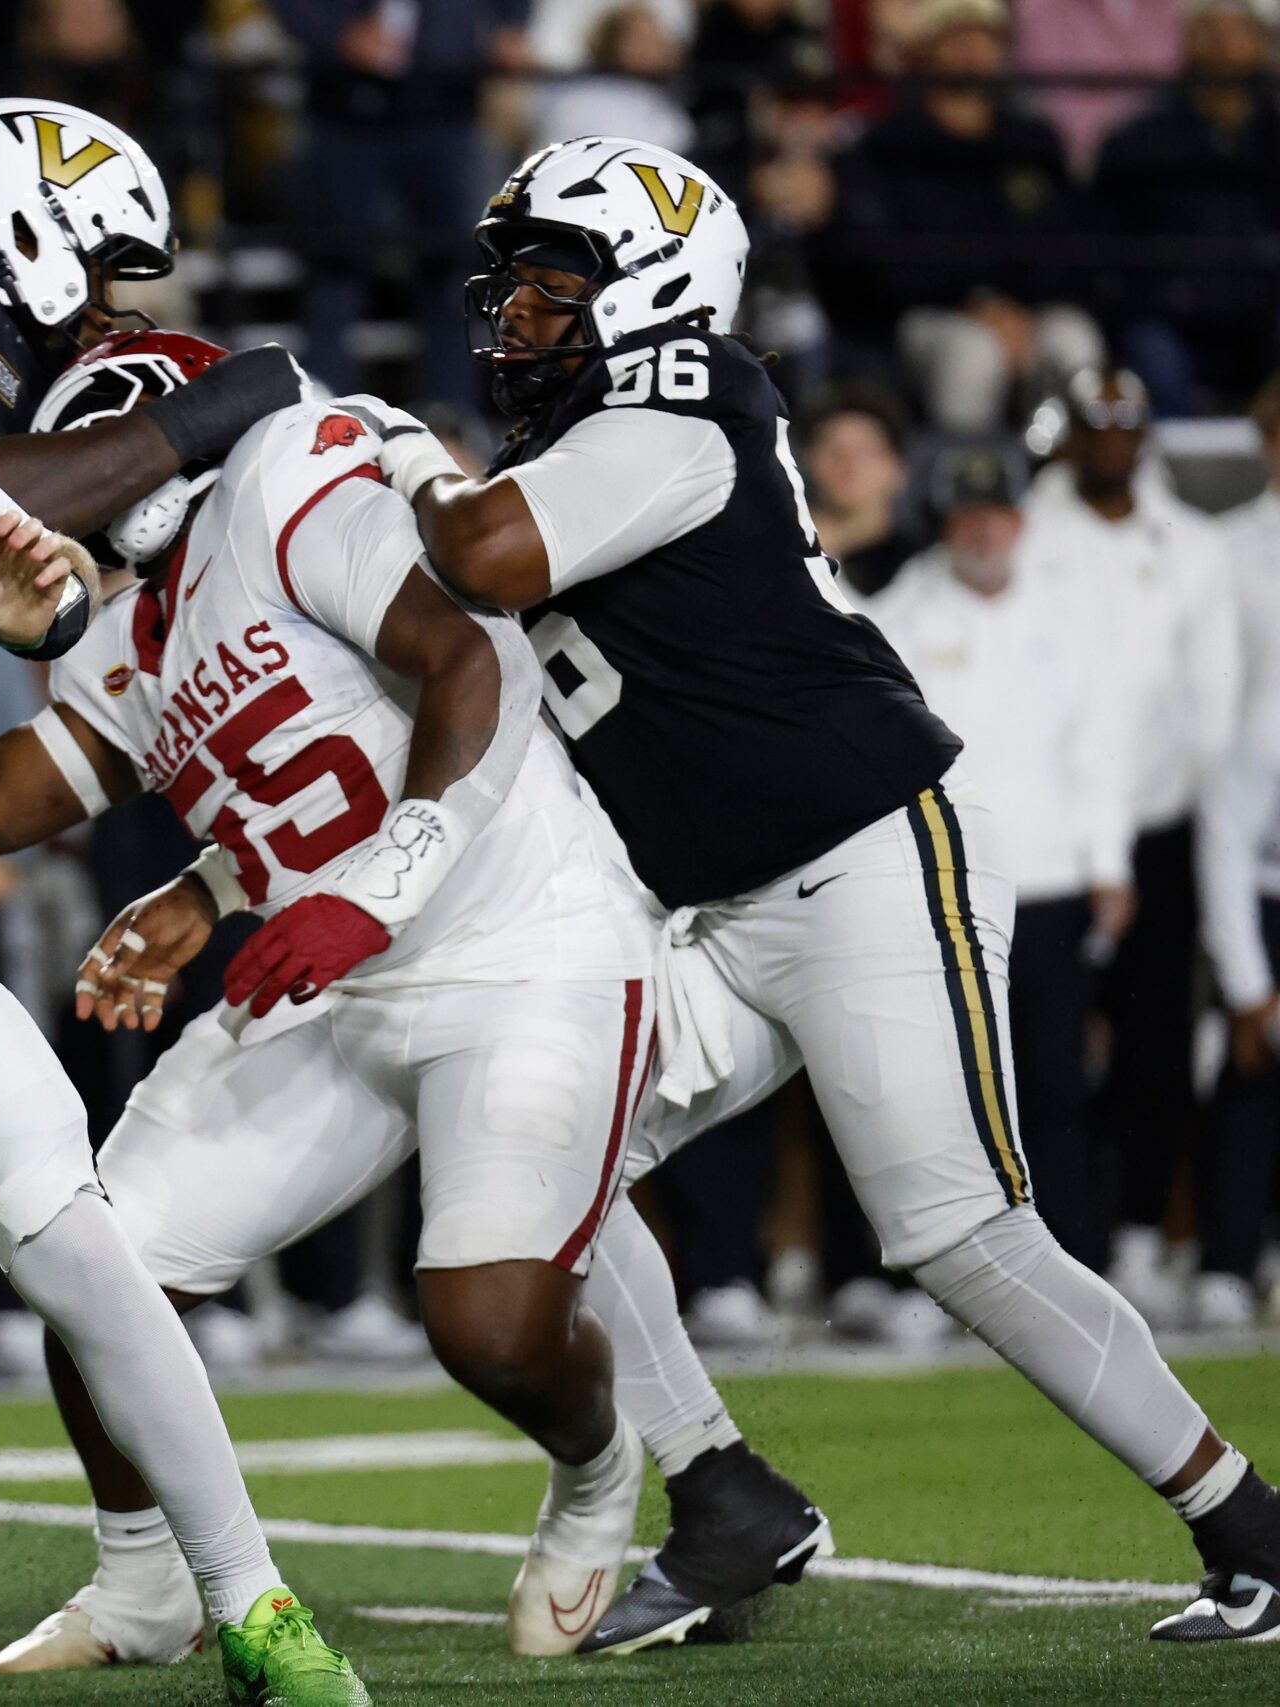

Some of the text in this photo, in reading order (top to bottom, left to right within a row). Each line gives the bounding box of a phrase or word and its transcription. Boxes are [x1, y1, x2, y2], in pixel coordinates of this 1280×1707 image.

[31, 115, 121, 190] V
[621, 162, 706, 238] V
[602, 338, 711, 407] 56
